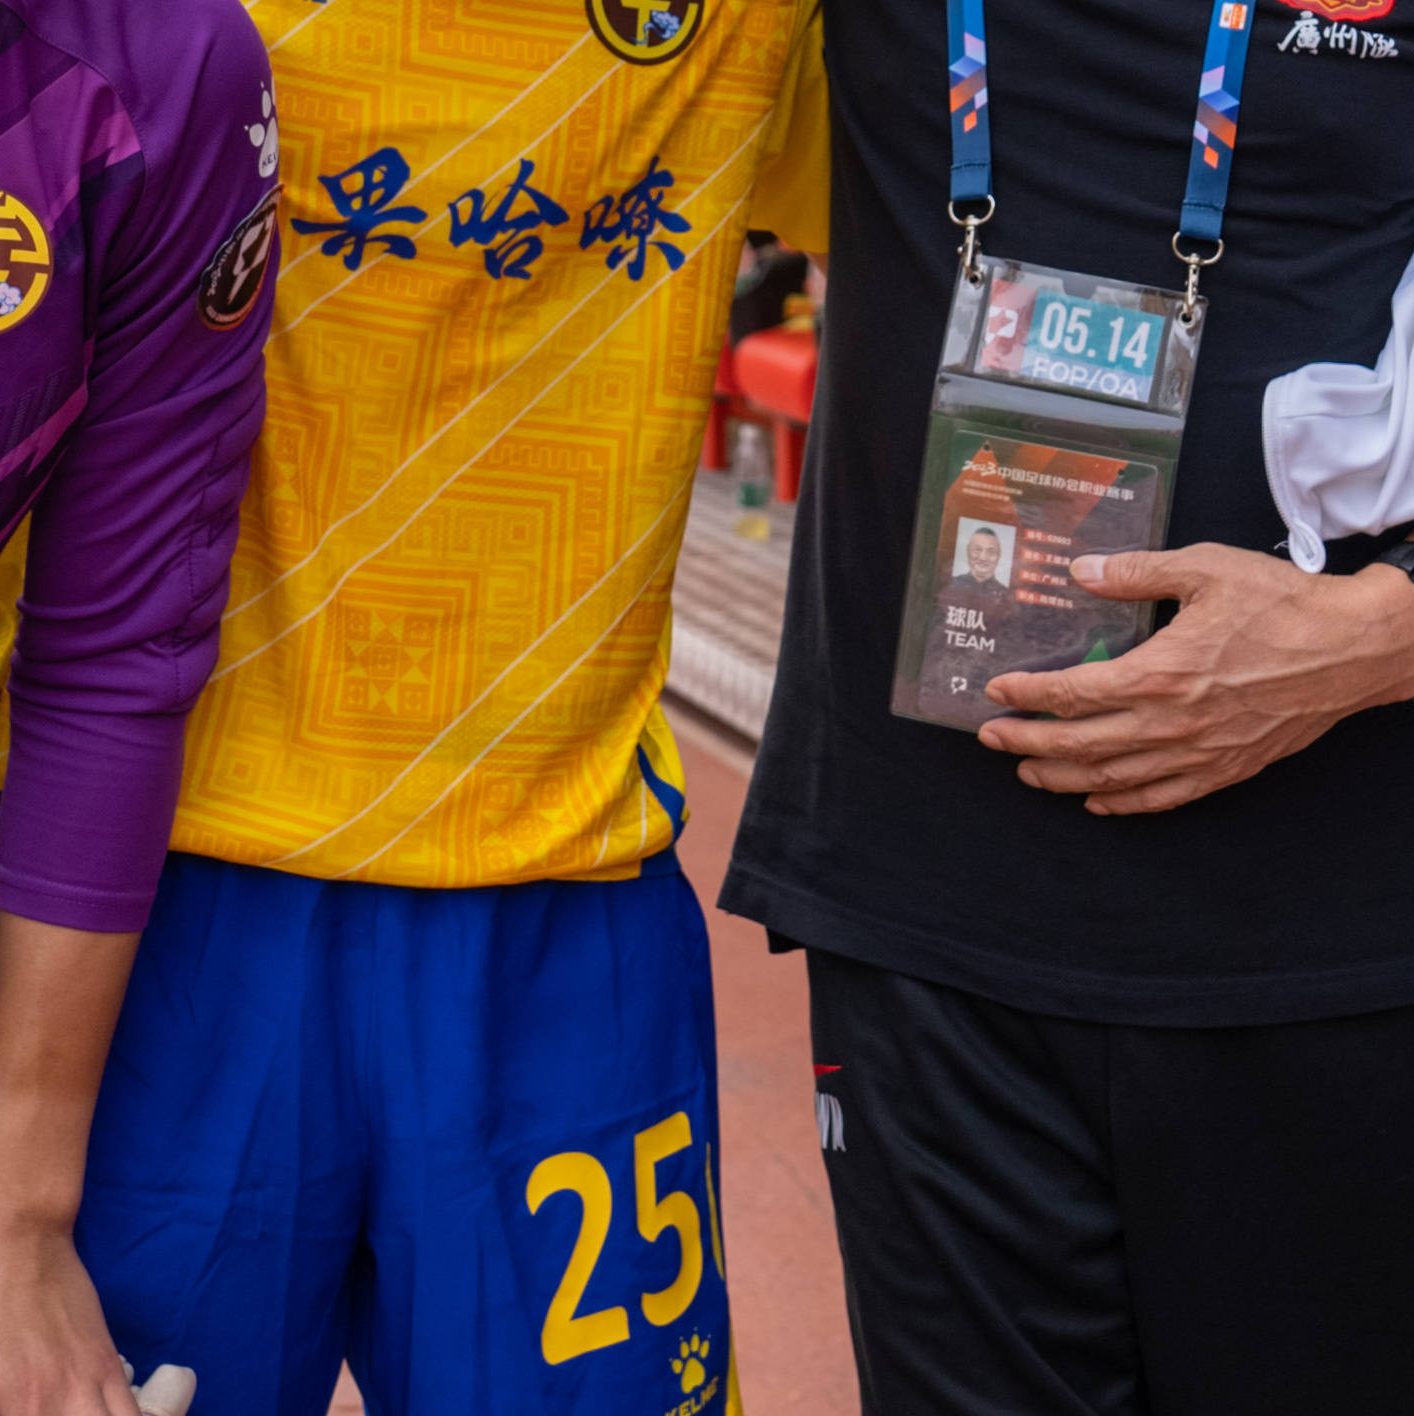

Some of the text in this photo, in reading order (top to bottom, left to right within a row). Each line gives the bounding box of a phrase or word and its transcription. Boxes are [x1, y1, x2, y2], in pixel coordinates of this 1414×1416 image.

[1039, 301, 1151, 369] 05.14
[1032, 356, 1139, 401] FOP/OA
[945, 605, 987, 632] 球队
[944, 629, 995, 654] TEAM
